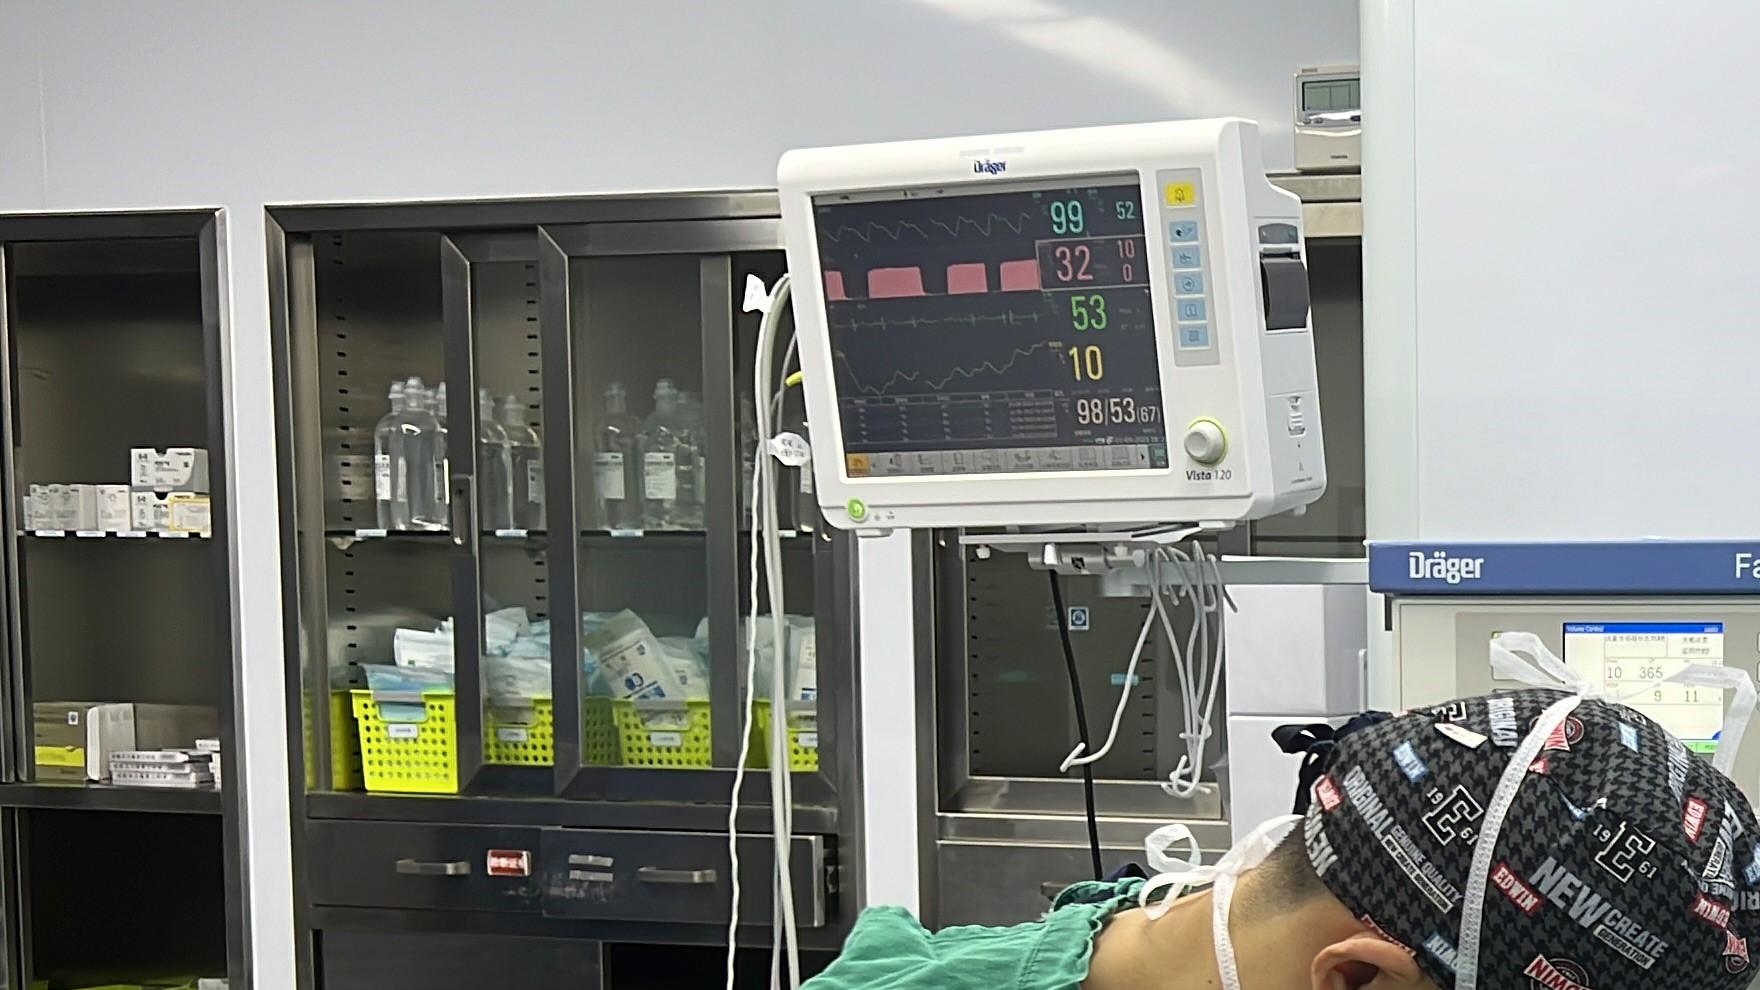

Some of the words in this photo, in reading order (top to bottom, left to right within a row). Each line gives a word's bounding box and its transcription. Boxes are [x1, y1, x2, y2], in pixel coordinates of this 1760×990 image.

[1050, 200, 1084, 234] 99
[1116, 201, 1136, 219] 52
[1055, 245, 1093, 281] 32
[1118, 239, 1135, 258] 10
[1071, 295, 1107, 330] 53
[1069, 345, 1103, 381] 10
[1186, 470, 1211, 480] Vista
[1215, 469, 1232, 480] 120
[1409, 551, 1485, 584] Dräger
[1607, 666, 1622, 679] 10
[1639, 666, 1663, 679] 365
[1684, 690, 1698, 702] 11
[1343, 765, 1394, 840] ORIGINAL
[1593, 824, 1611, 842] 19
[1595, 821, 1656, 883] E
[1638, 861, 1657, 878] 61
[1493, 866, 1538, 912] EDWIN
[1529, 856, 1612, 928] NEW
[1604, 909, 1669, 958] CREATE
